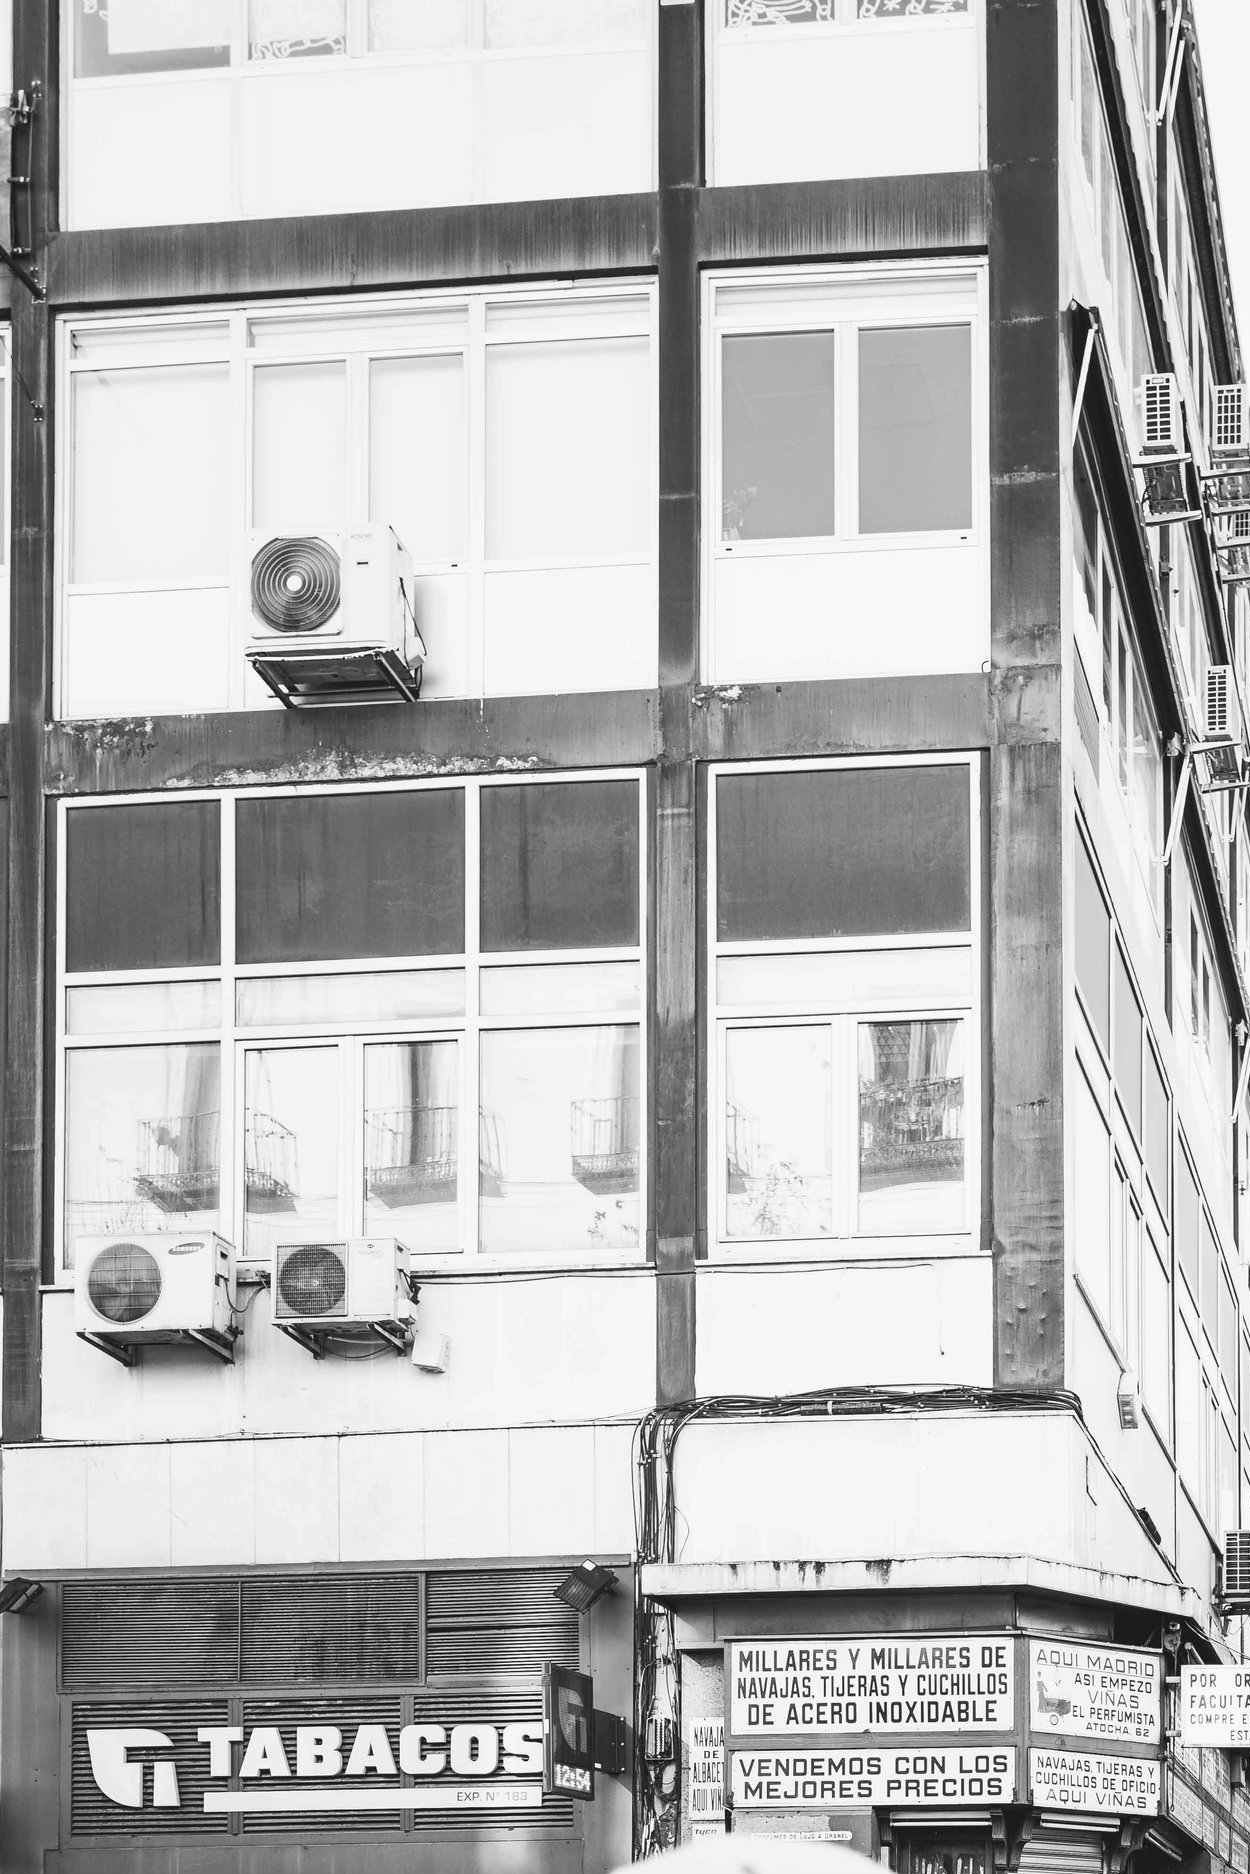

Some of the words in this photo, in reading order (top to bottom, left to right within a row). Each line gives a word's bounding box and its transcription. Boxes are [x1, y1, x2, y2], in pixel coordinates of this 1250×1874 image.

[739, 1649, 837, 1672] MILLARES
[848, 1648, 861, 1670] Y
[871, 1647, 971, 1669] MILLARES
[981, 1646, 1007, 1668] DE
[1036, 1649, 1079, 1668] AQUI
[1087, 1655, 1155, 1677] MADRID
[738, 1675, 815, 1699] NAVAJAS,
[820, 1675, 890, 1698] TIJERAS
[898, 1674, 909, 1696] Y
[917, 1673, 1008, 1696] CUCHILLOS
[1074, 1672, 1095, 1687] ASI
[1101, 1676, 1153, 1694] EMPEZO
[1190, 1673, 1217, 1687] POR
[1088, 1689, 1140, 1709] VIÑAS
[747, 1703, 774, 1725] DE
[786, 1702, 858, 1725] ACERO
[869, 1700, 998, 1723] INOXIDABLE
[1072, 1706, 1085, 1718] EL
[1090, 1708, 1156, 1727] PERFUMISTA
[1190, 1713, 1235, 1724] COMPRE
[694, 1726, 724, 1748] NAVAJA
[1135, 1728, 1150, 1738] 62
[197, 1723, 543, 1778] TABACOS
[704, 1750, 720, 1759] DE
[555, 1763, 591, 1791] 12:54
[693, 1762, 724, 1784] ALBACET
[739, 1757, 882, 1777] VENDEMOS
[895, 1756, 946, 1774] CON
[959, 1755, 1008, 1773] LOS
[1096, 1761, 1143, 1778] TIJERAS
[1148, 1767, 1155, 1779] Y
[744, 1780, 873, 1799] MEJORES
[886, 1778, 1003, 1798] PRECIOS
[1035, 1771, 1097, 1789] CUCHILLOS
[1102, 1777, 1117, 1791] DE
[1121, 1779, 1156, 1795] OFICIO
[457, 1791, 482, 1801] EXP.
[505, 1791, 529, 1801] 183
[693, 1788, 708, 1811] AQUI
[1046, 1788, 1087, 1804] AQUI
[1095, 1791, 1147, 1809] VIÑAS
[695, 1828, 717, 1836] tyco
